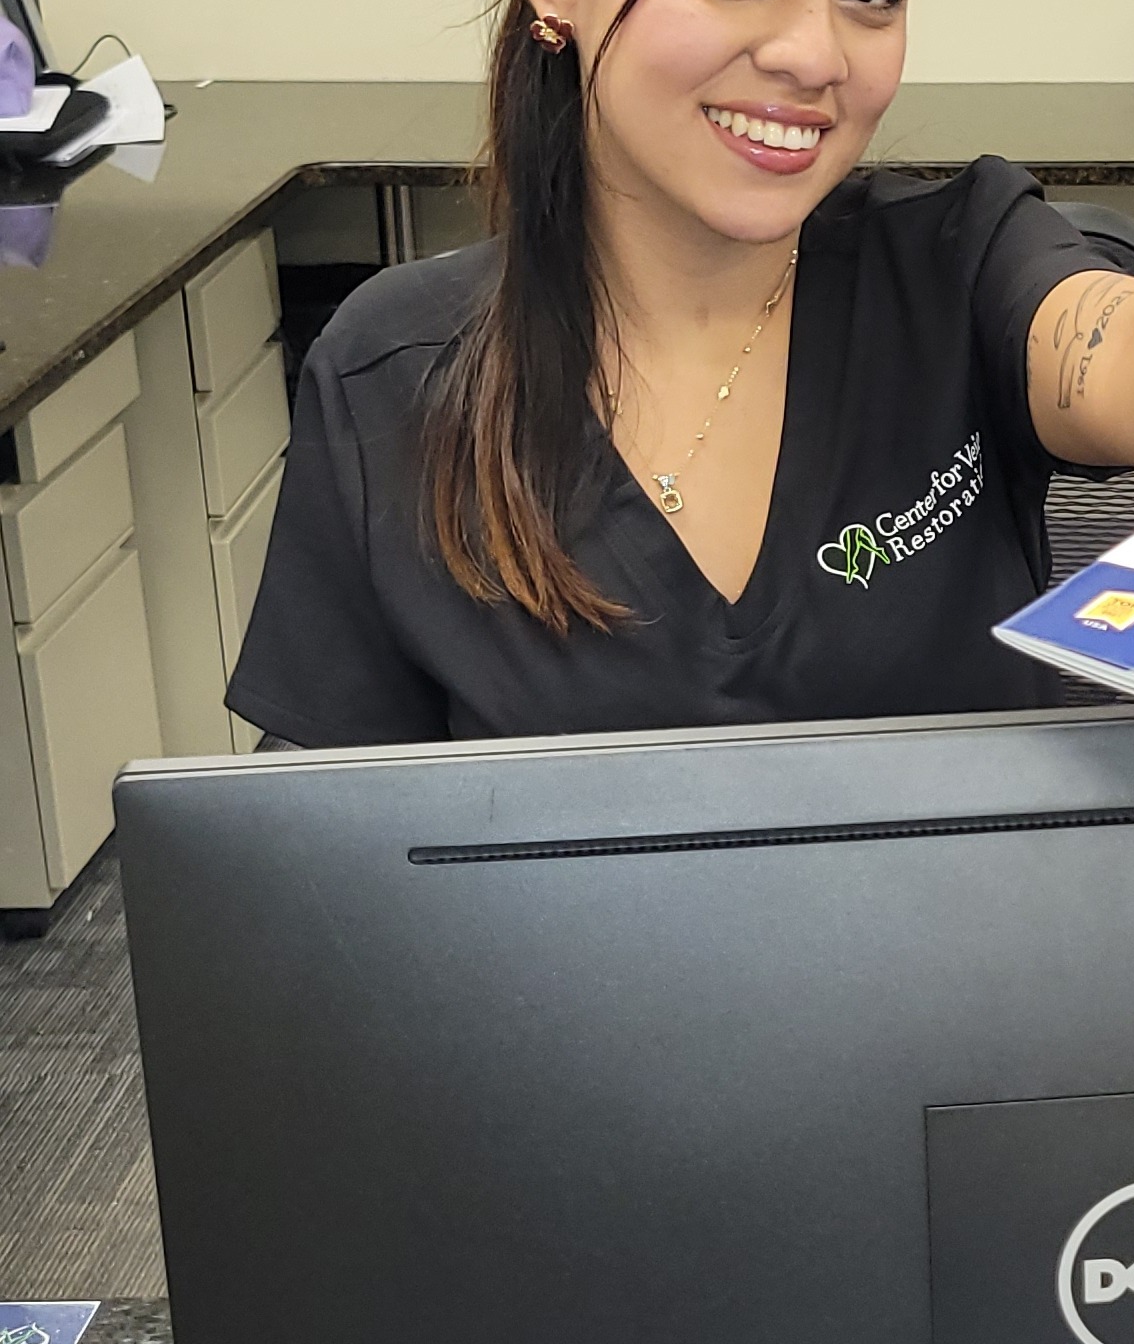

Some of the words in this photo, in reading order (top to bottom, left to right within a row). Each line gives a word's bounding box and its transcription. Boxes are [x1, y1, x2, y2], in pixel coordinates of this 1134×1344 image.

[876, 488, 937, 537] Center
[930, 463, 963, 496] for
[886, 453, 984, 562] Restorati
